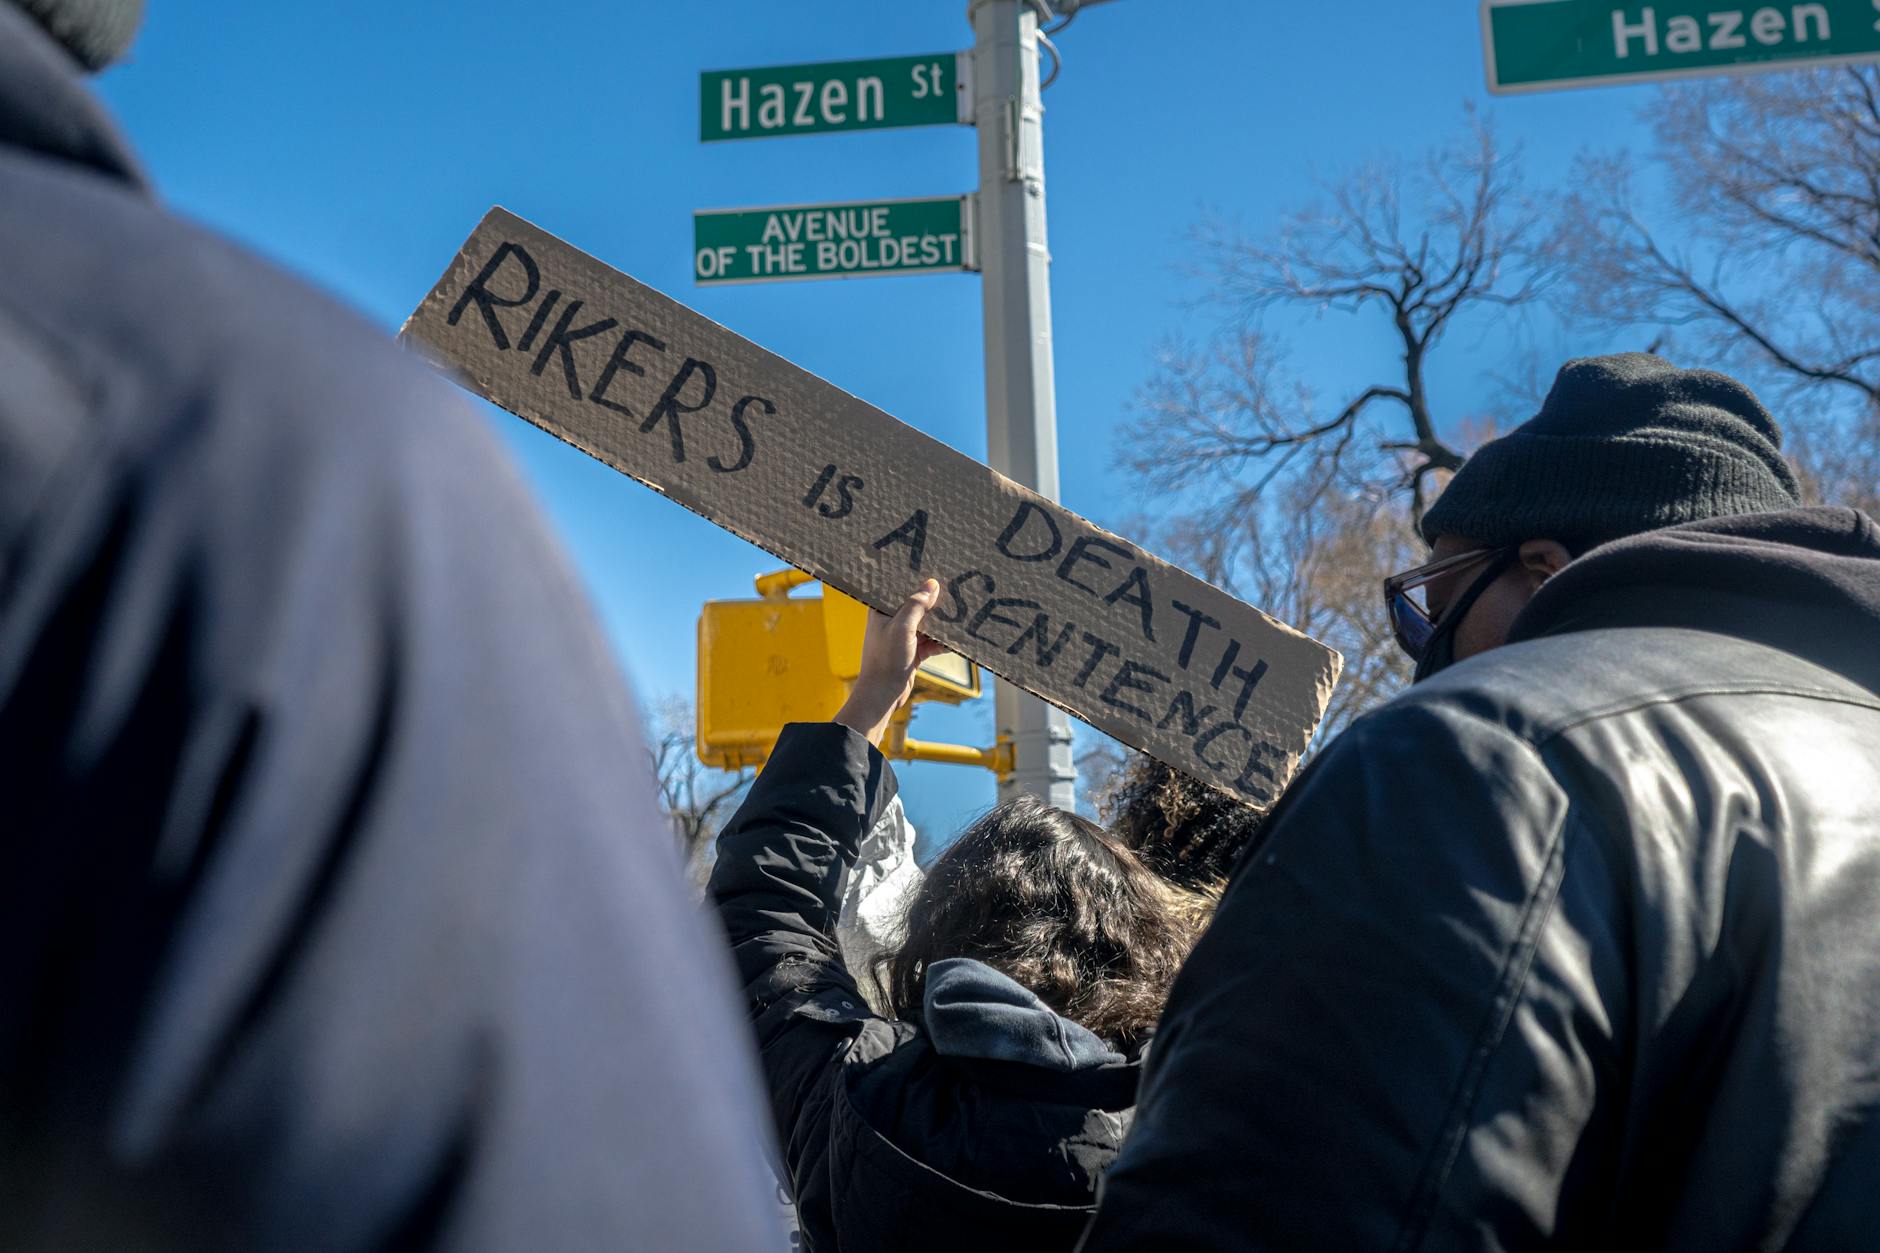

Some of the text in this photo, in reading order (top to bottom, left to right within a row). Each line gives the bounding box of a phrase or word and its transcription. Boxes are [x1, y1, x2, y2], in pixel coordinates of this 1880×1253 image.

[1612, 2, 1831, 58] Hazen
[720, 63, 943, 131] Hazen St
[696, 234, 957, 277] OF THE BOLDEST
[762, 208, 890, 243] AVENUE
[447, 242, 929, 571] RIKERS IS A
[995, 501, 1269, 723] DEATH
[932, 570, 1287, 801] SENTENCE
